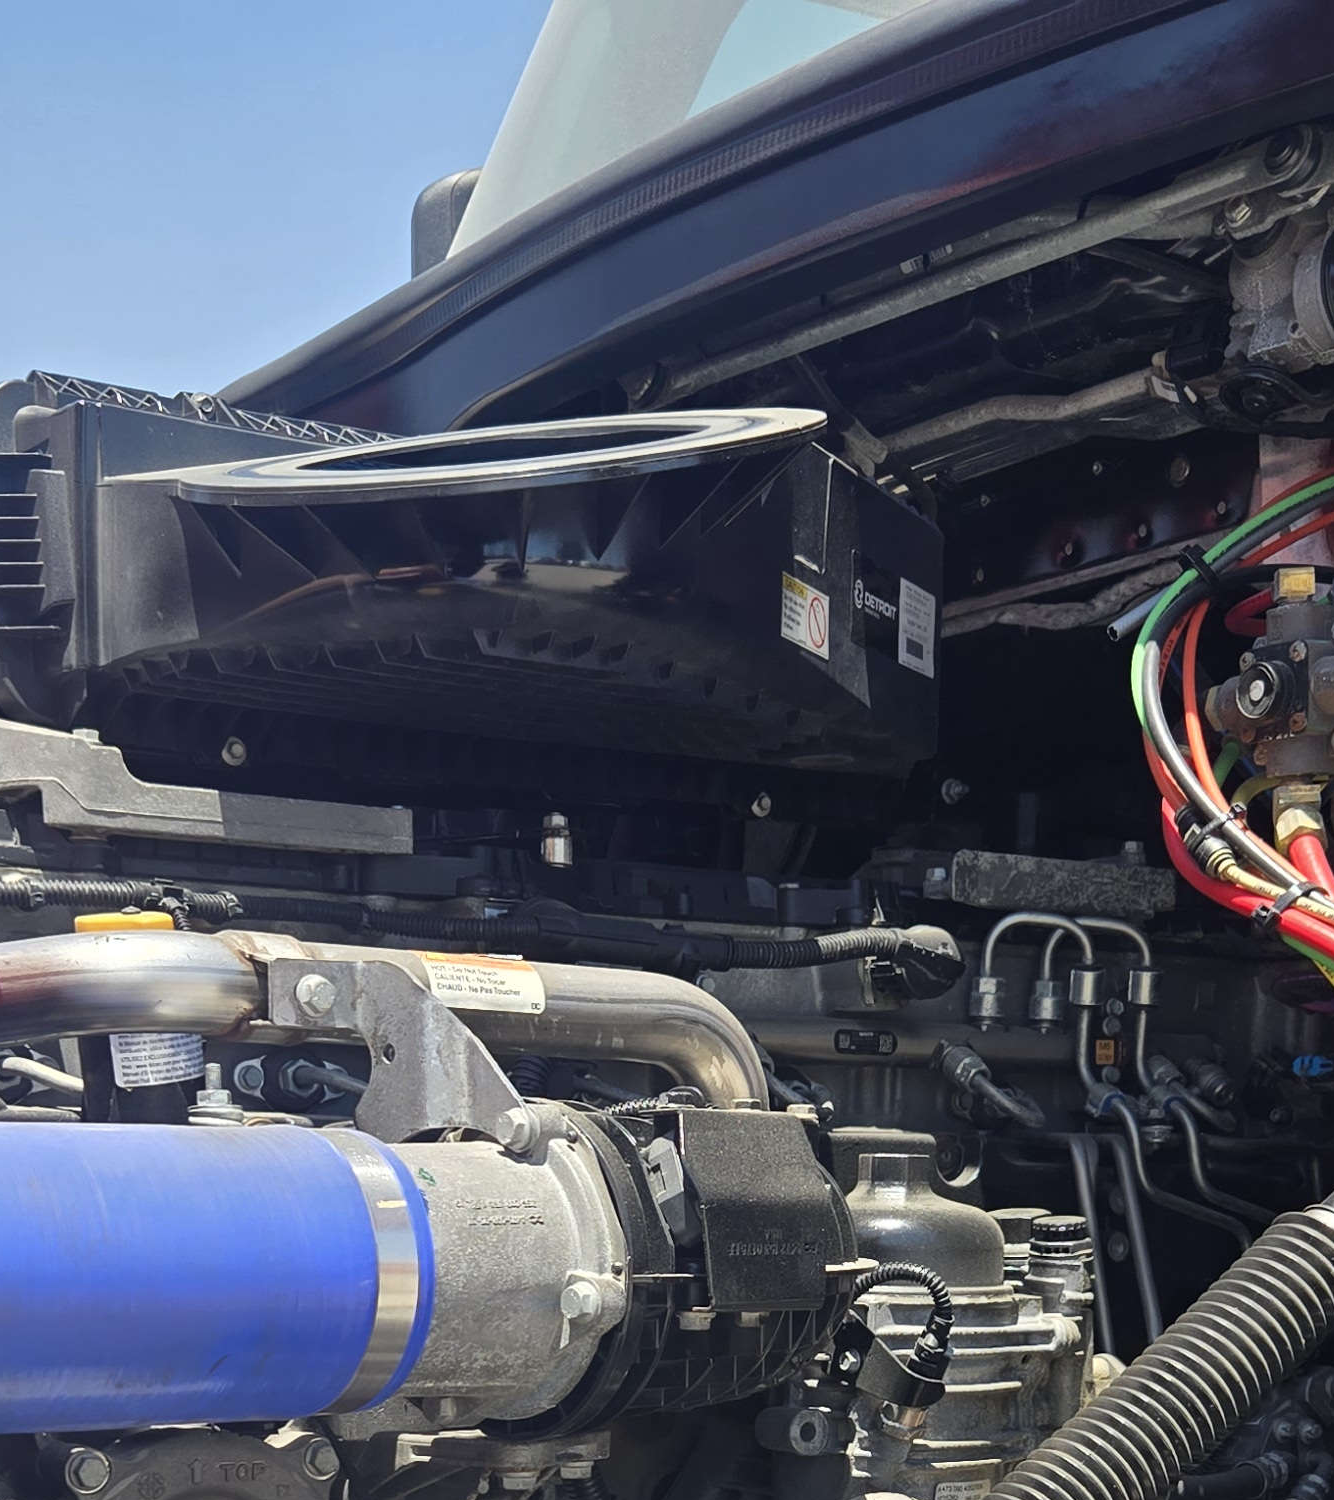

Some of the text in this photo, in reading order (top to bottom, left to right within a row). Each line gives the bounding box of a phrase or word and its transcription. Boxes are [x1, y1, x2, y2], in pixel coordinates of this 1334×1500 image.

[864, 591, 897, 620] DETROIT
[434, 973, 470, 983] CALIENTE
[437, 983, 463, 991] CHAUD
[480, 986, 493, 994] Pas
[494, 987, 521, 996] Toucher
[531, 1002, 541, 1010] DC
[218, 1460, 267, 1482] TOP
